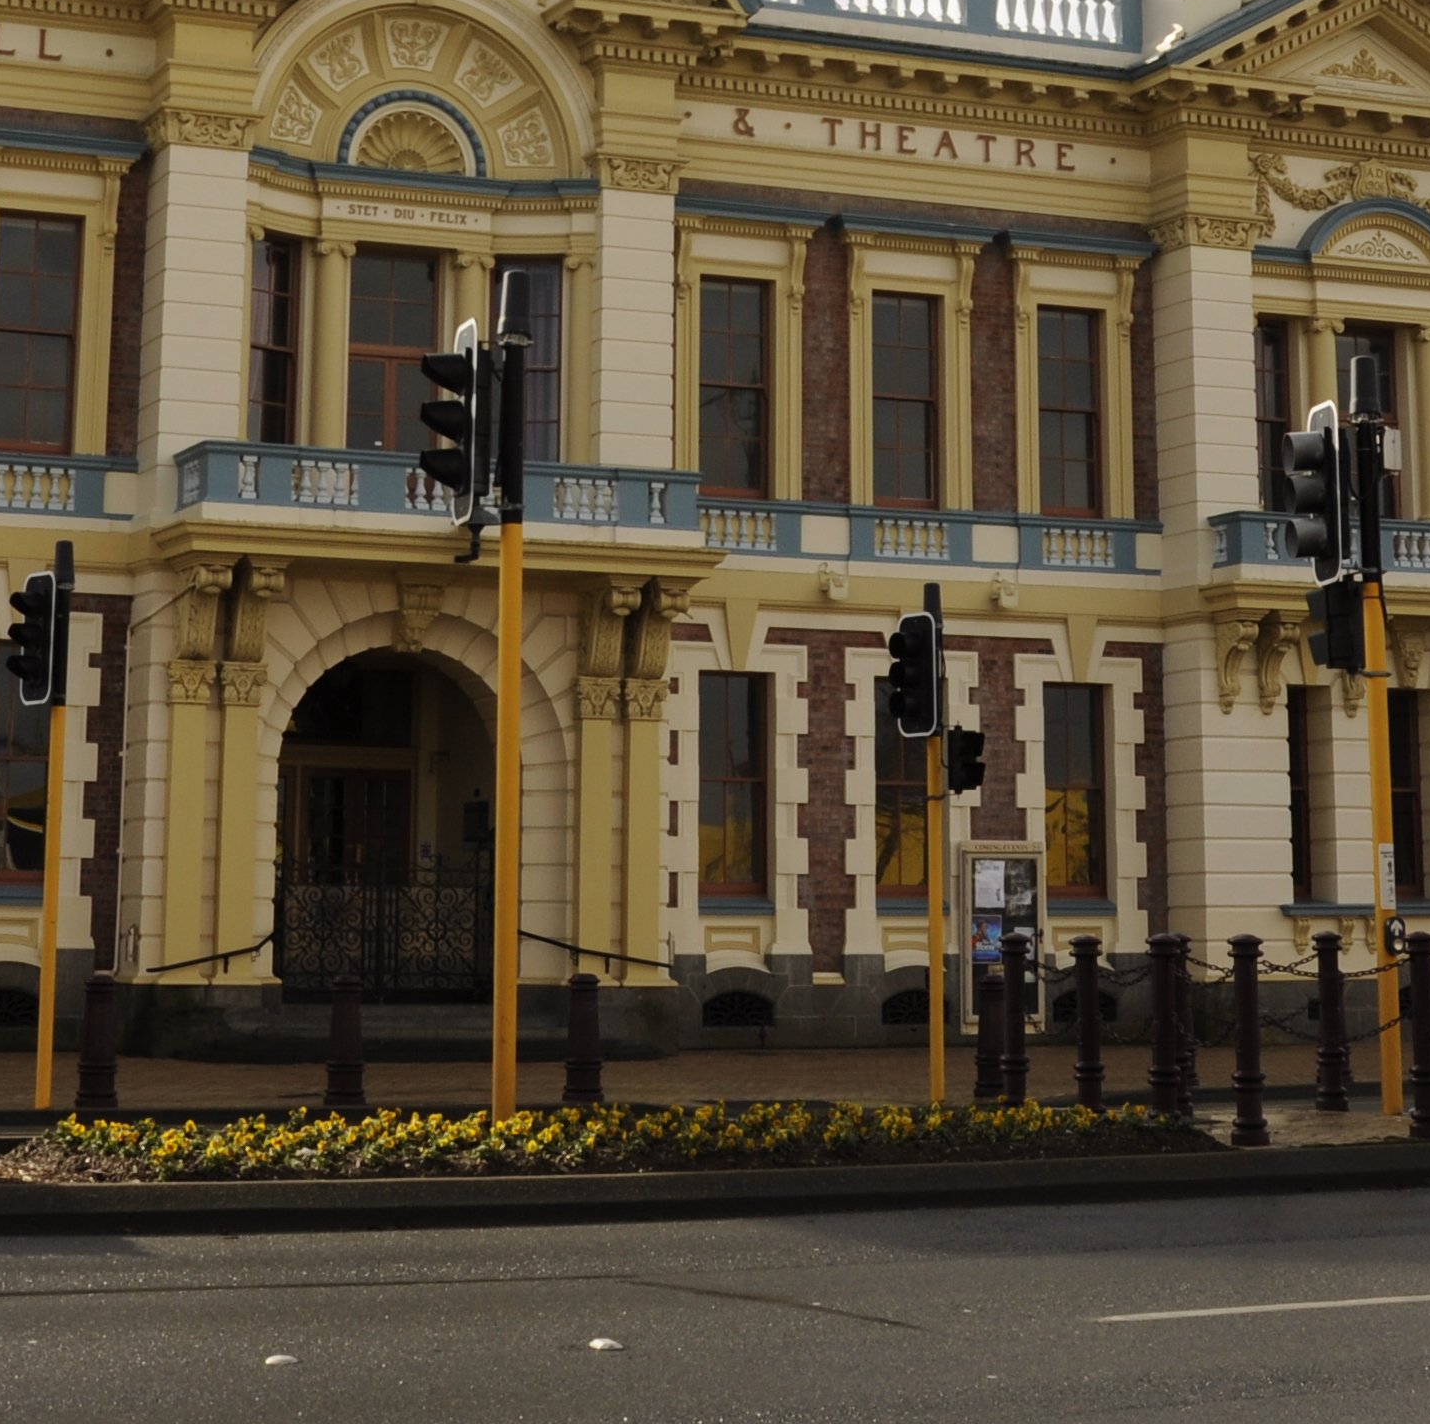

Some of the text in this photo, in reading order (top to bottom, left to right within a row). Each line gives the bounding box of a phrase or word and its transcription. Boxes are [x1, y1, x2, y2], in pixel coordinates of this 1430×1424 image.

[732, 107, 1076, 172] & THEATRE
[347, 203, 468, 226] STET DIU FELIX
